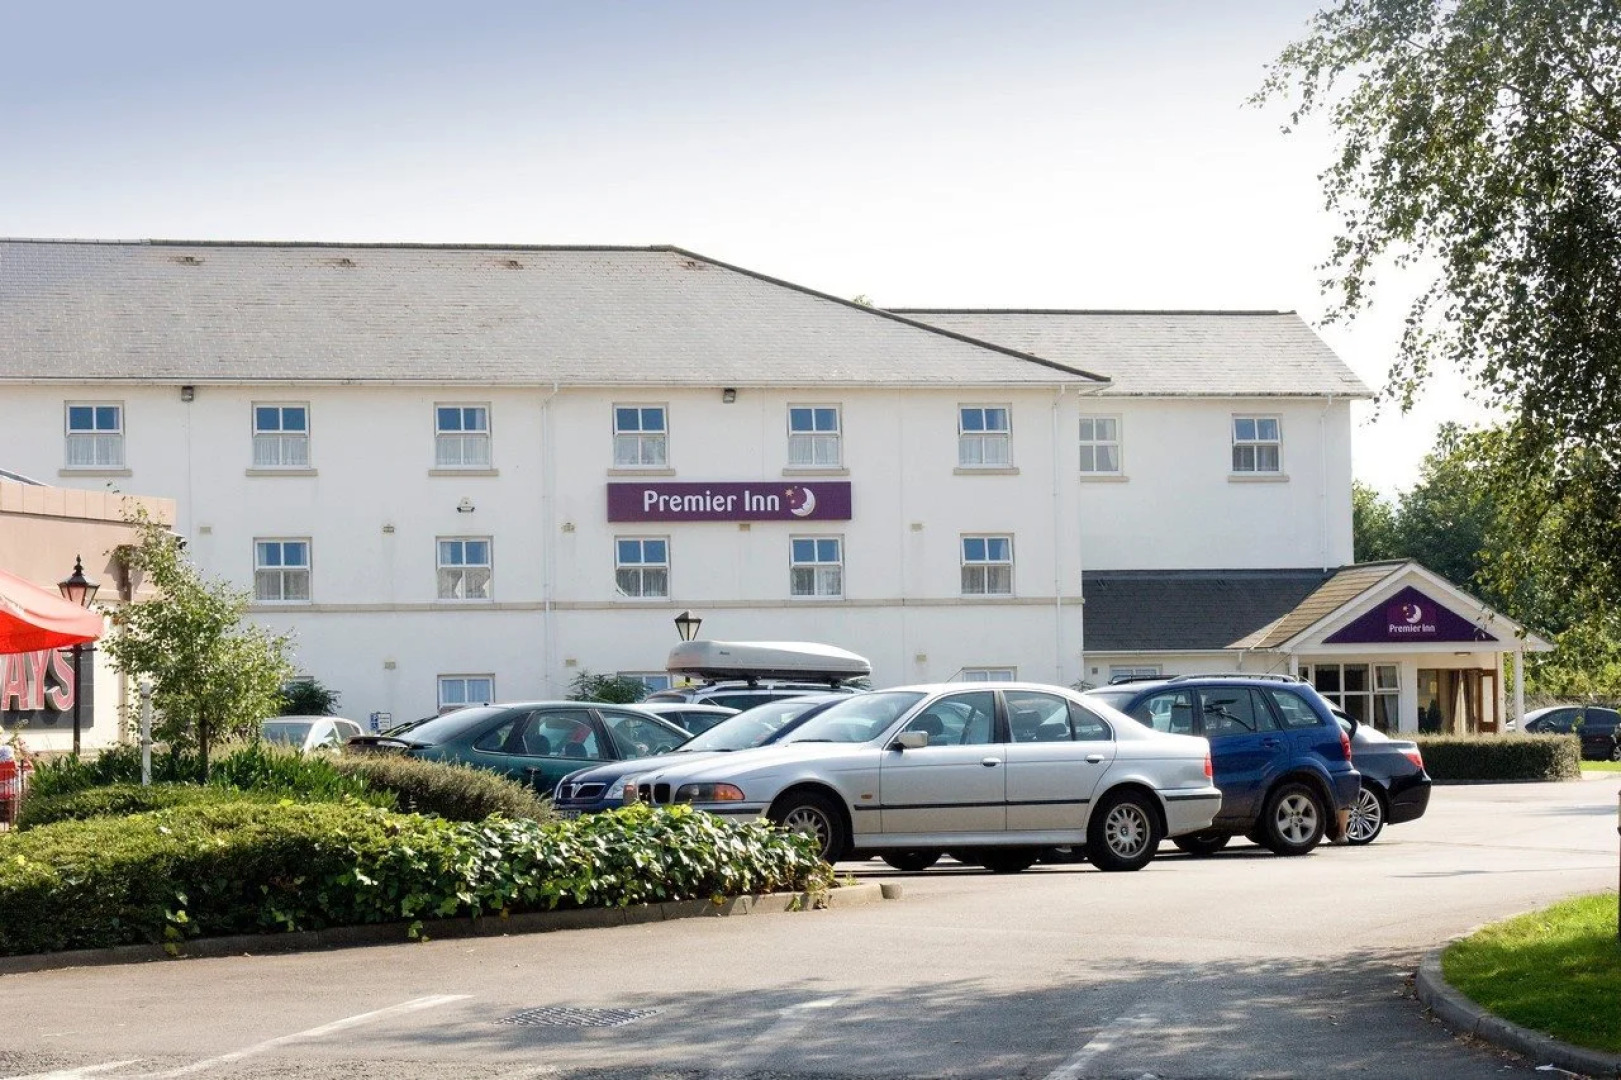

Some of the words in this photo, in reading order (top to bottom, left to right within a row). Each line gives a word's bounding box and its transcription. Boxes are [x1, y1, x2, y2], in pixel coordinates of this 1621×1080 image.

[643, 490, 738, 512] Premier
[744, 490, 780, 512] Inn
[1389, 623, 1421, 633] Premier
[1421, 623, 1436, 633] Inn
